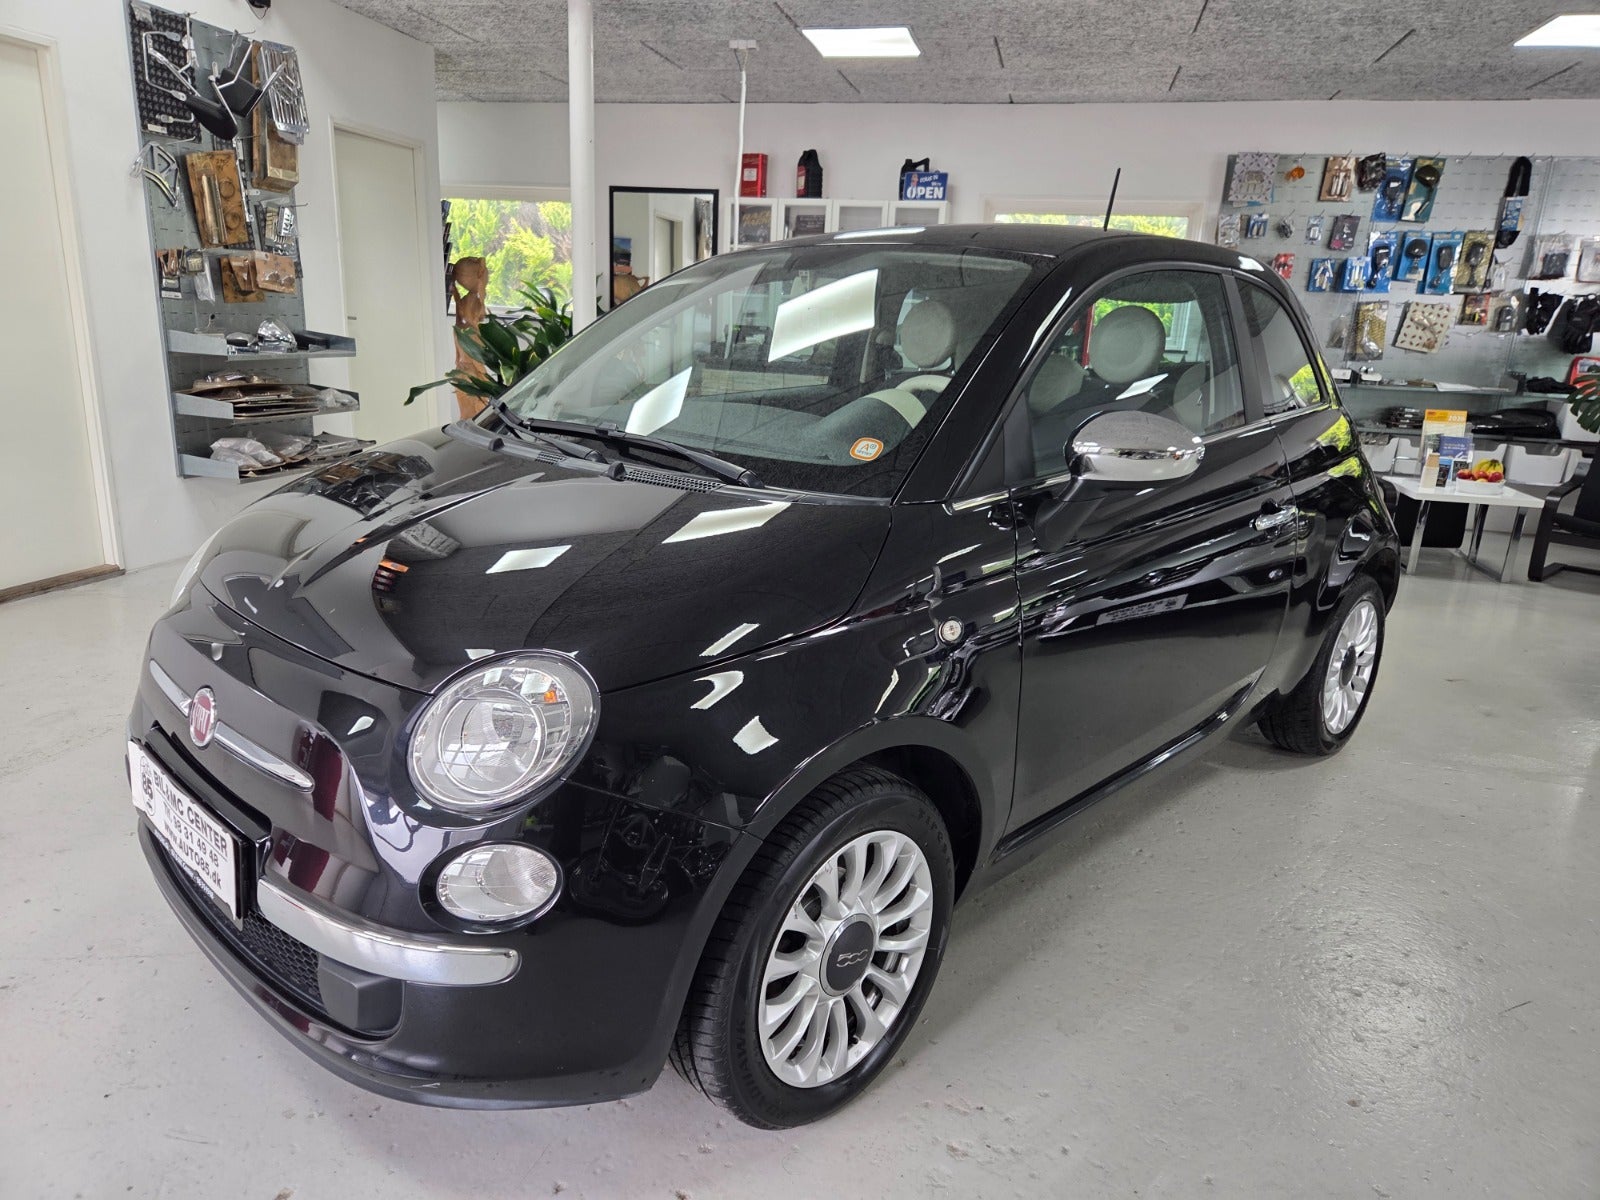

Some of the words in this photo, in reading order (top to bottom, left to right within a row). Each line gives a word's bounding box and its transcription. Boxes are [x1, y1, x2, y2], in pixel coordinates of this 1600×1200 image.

[906, 186, 944, 199] OPEN
[184, 826, 194, 844] 31
[197, 837, 207, 855] 49
[187, 806, 228, 857] CENTER
[836, 949, 869, 968] 500
